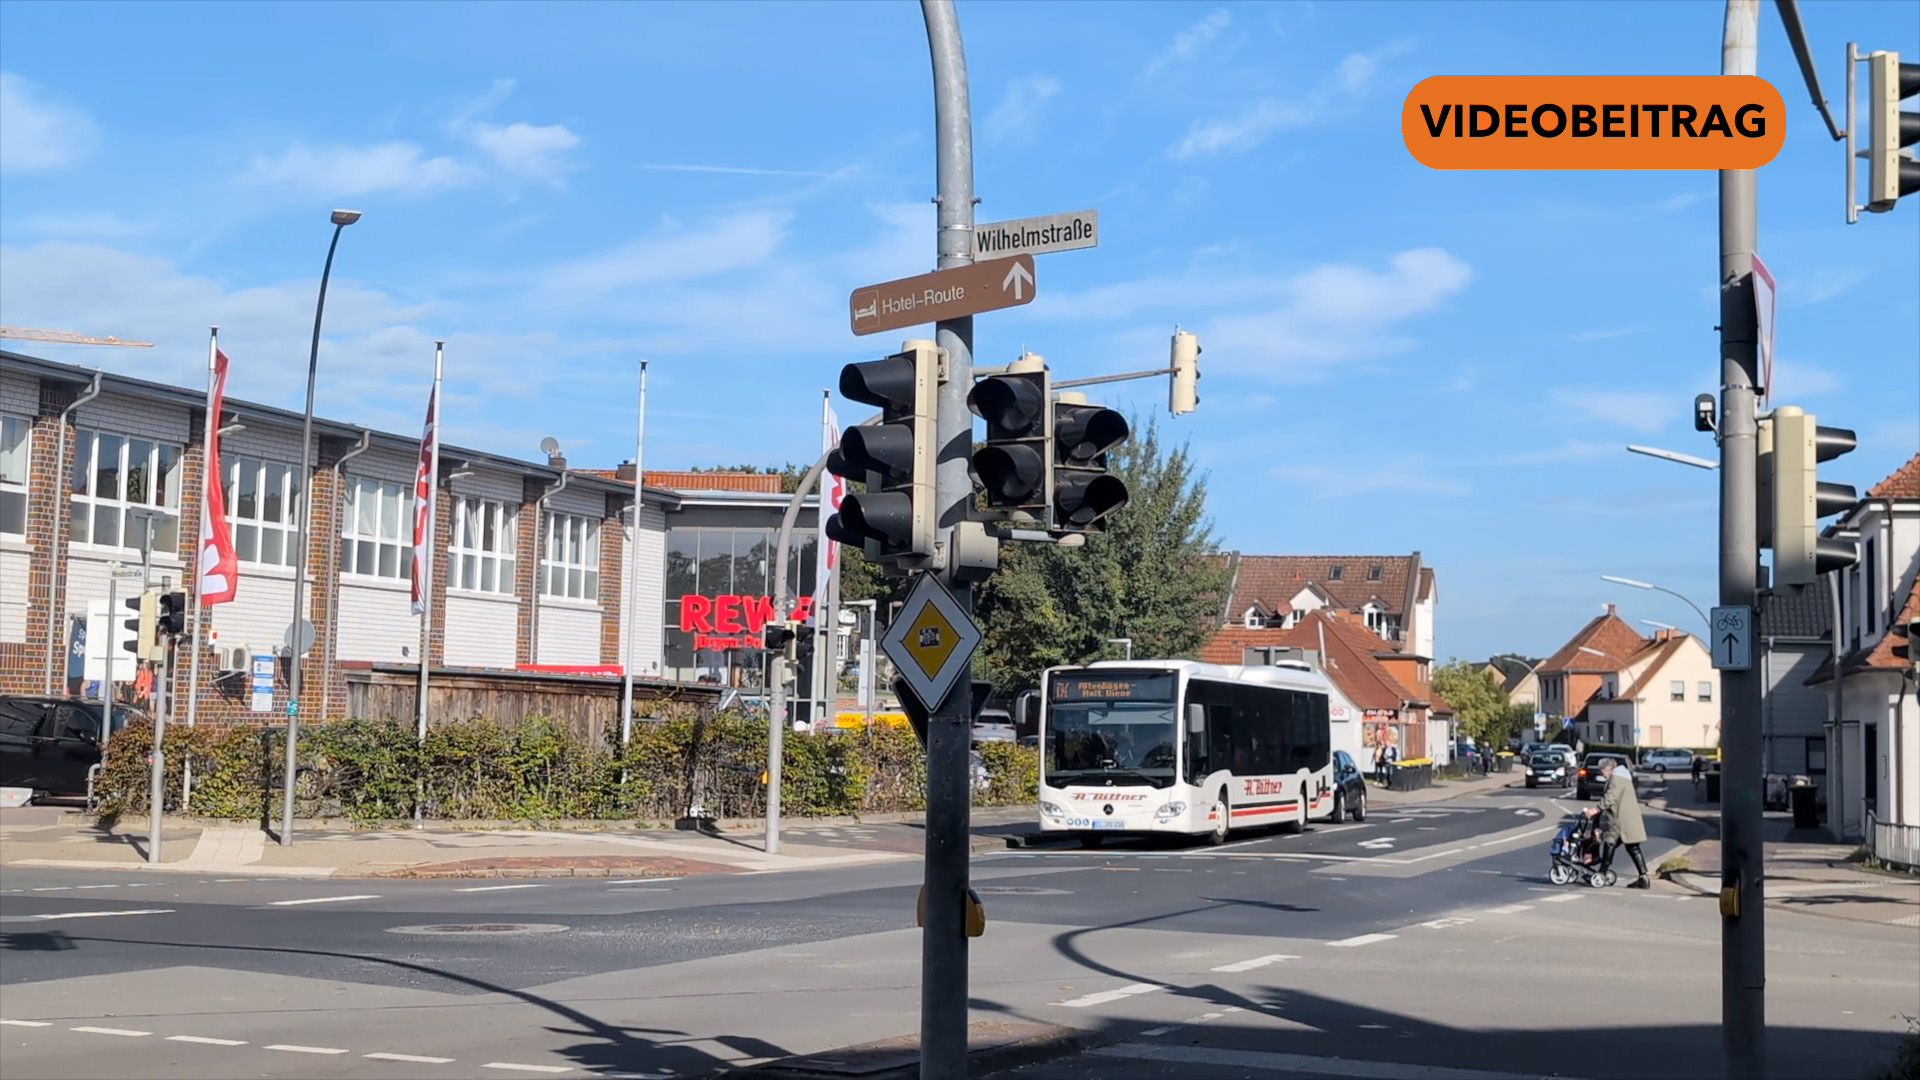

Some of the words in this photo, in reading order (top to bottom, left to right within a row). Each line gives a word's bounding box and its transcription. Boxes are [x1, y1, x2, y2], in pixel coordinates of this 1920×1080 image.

[977, 218, 1092, 252] Wilhelmstraße
[882, 285, 965, 315] Hotel-Route
[72, 641, 86, 658] Sp
[1088, 792, 1147, 801] Bittner
